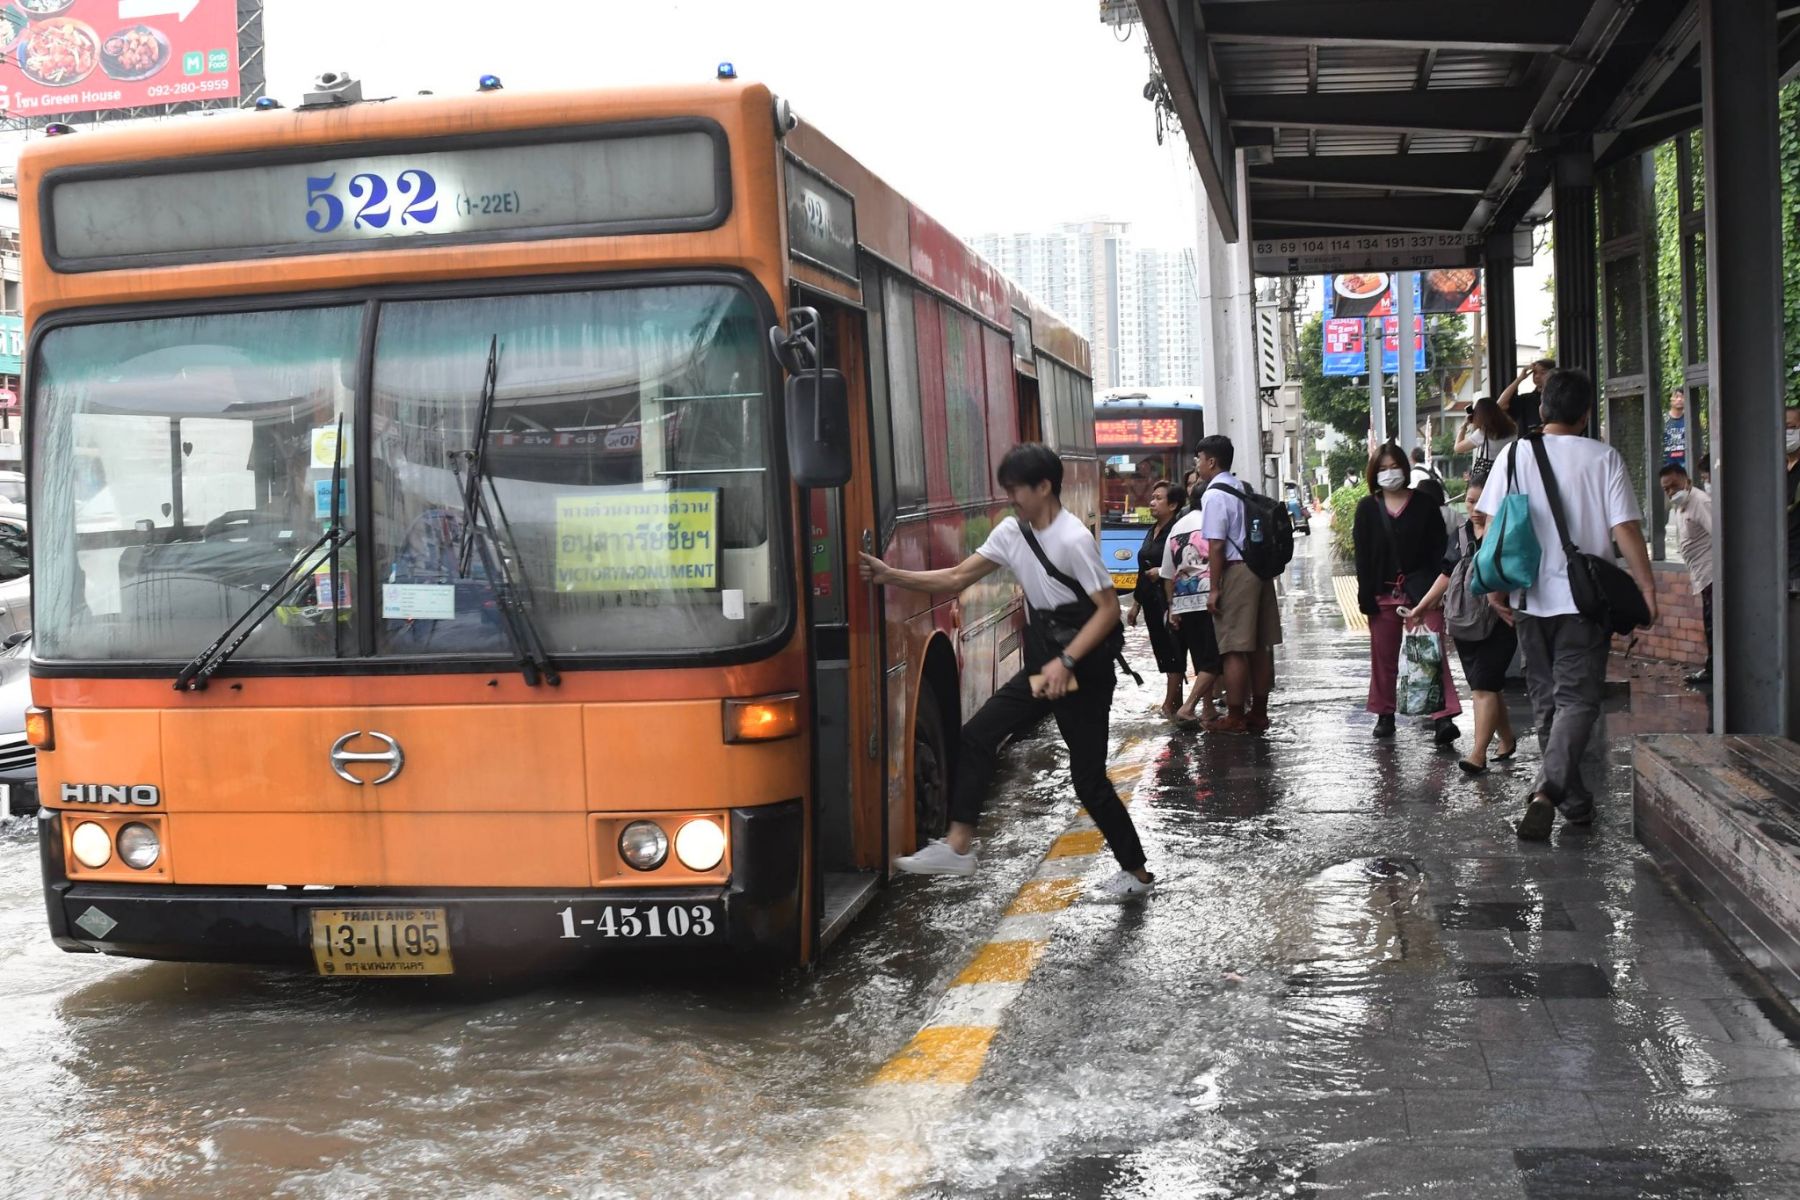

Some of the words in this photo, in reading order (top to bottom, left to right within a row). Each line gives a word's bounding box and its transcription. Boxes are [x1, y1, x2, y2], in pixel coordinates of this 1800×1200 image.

[41, 94, 79, 107] Green
[81, 90, 122, 104] House
[147, 80, 229, 97] 092-280-5959
[306, 169, 439, 233] 522
[456, 190, 520, 218] (1-22E)
[1257, 243, 1273, 254] 63
[1280, 242, 1296, 253] 69
[1302, 240, 1324, 252] 104
[1331, 239, 1351, 251] 114
[1357, 238, 1379, 250] 134
[1385, 237, 1406, 248] 191
[1410, 236, 1434, 248] 337
[1438, 235, 1462, 247] 522
[1140, 419, 1178, 444] 522
[61, 783, 159, 806] HINO
[341, 911, 416, 921] THAILAND
[557, 905, 715, 939] 1-45103
[325, 924, 440, 957] 13-1195
